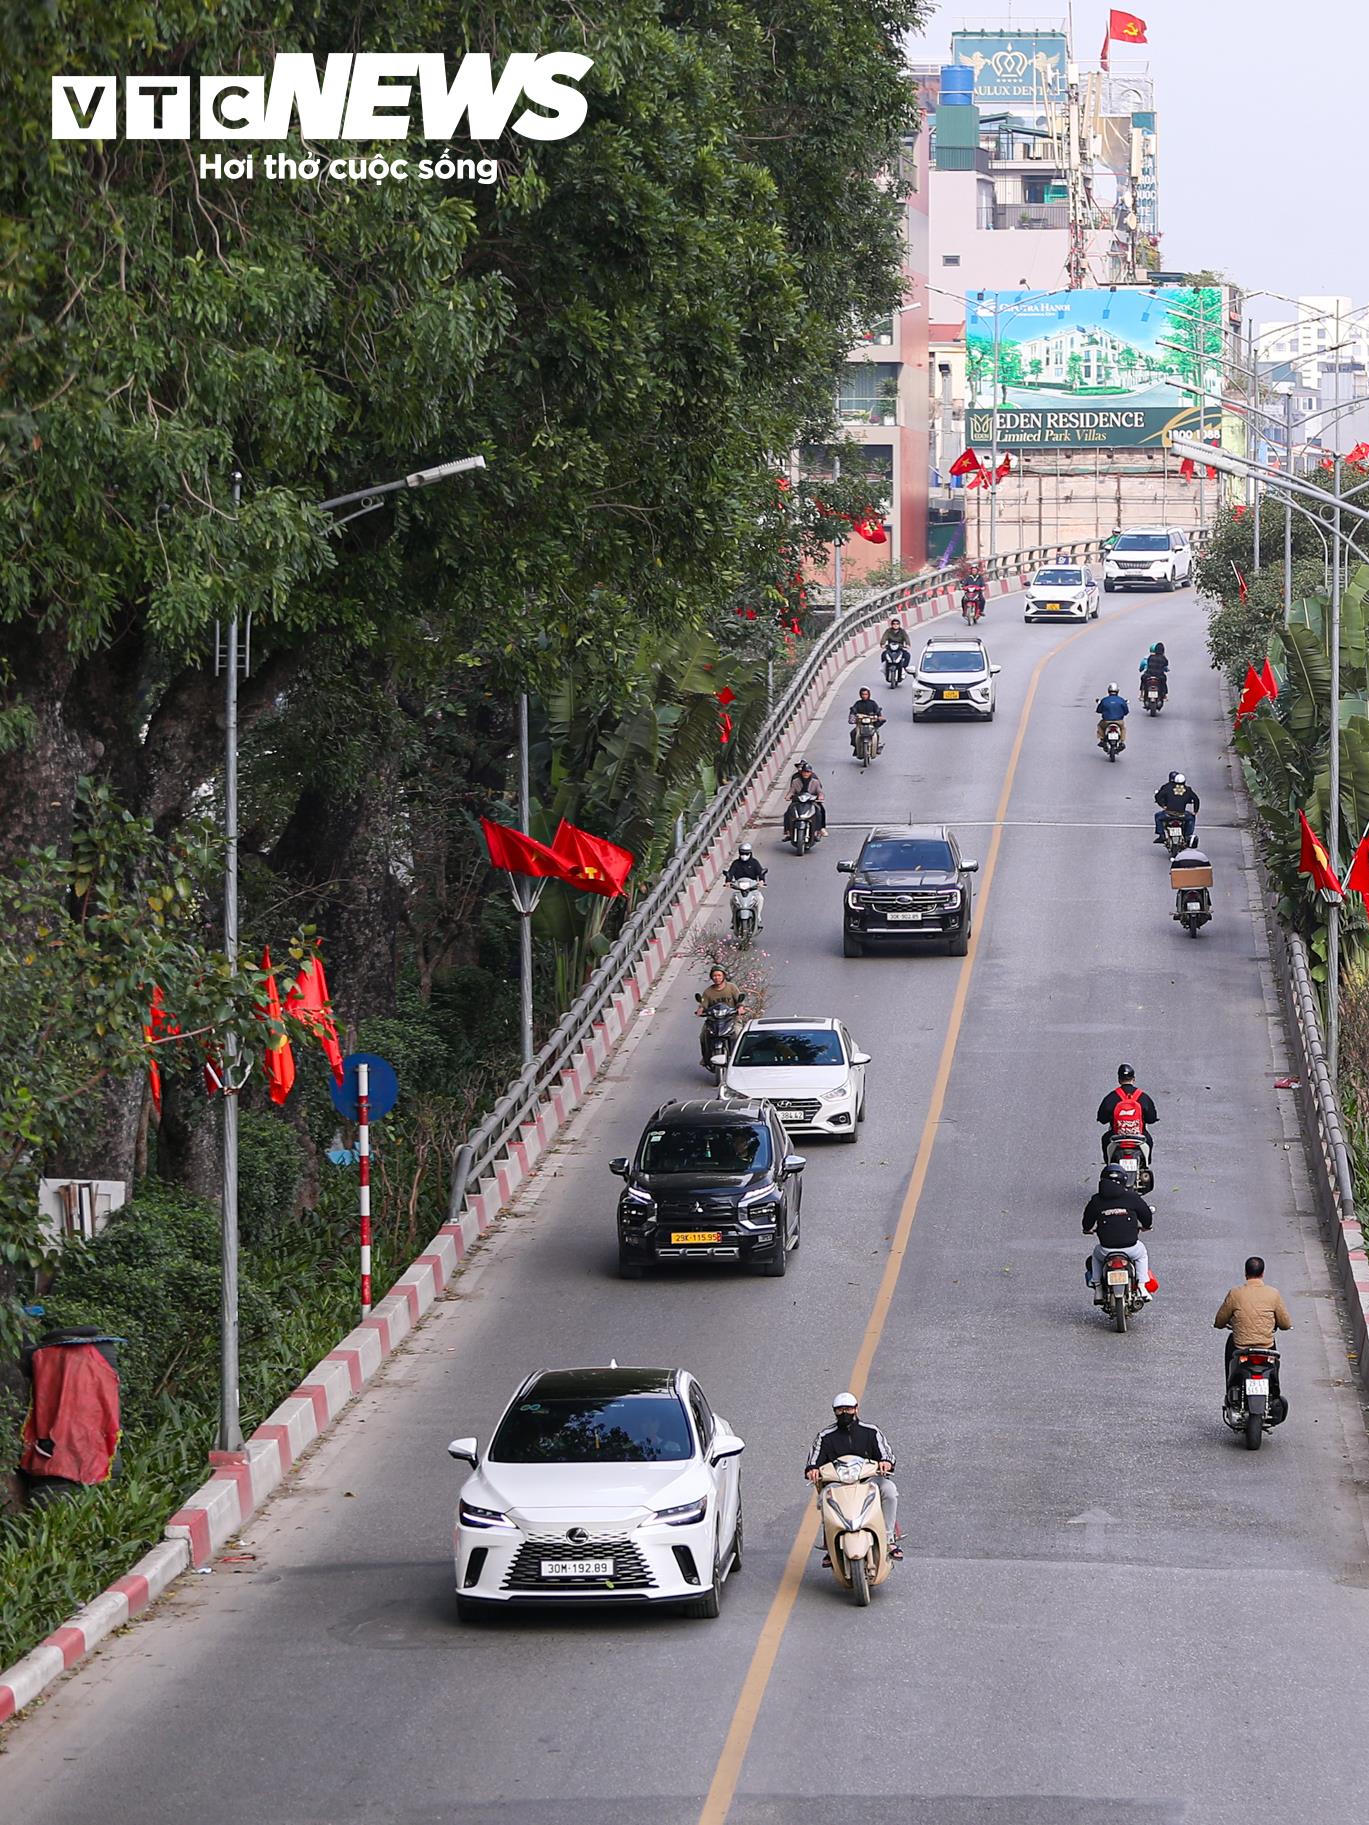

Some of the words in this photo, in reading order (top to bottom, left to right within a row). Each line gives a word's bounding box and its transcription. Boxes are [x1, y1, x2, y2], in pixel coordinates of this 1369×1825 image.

[974, 85, 1010, 96] AULUX
[996, 412, 1043, 429] EDEN
[1046, 411, 1145, 429] RESIDENCE
[996, 429, 1042, 443] Limited
[1044, 429, 1072, 442] Park
[1075, 429, 1107, 441] Villas
[547, 1562, 608, 1574] 30M-192.89
